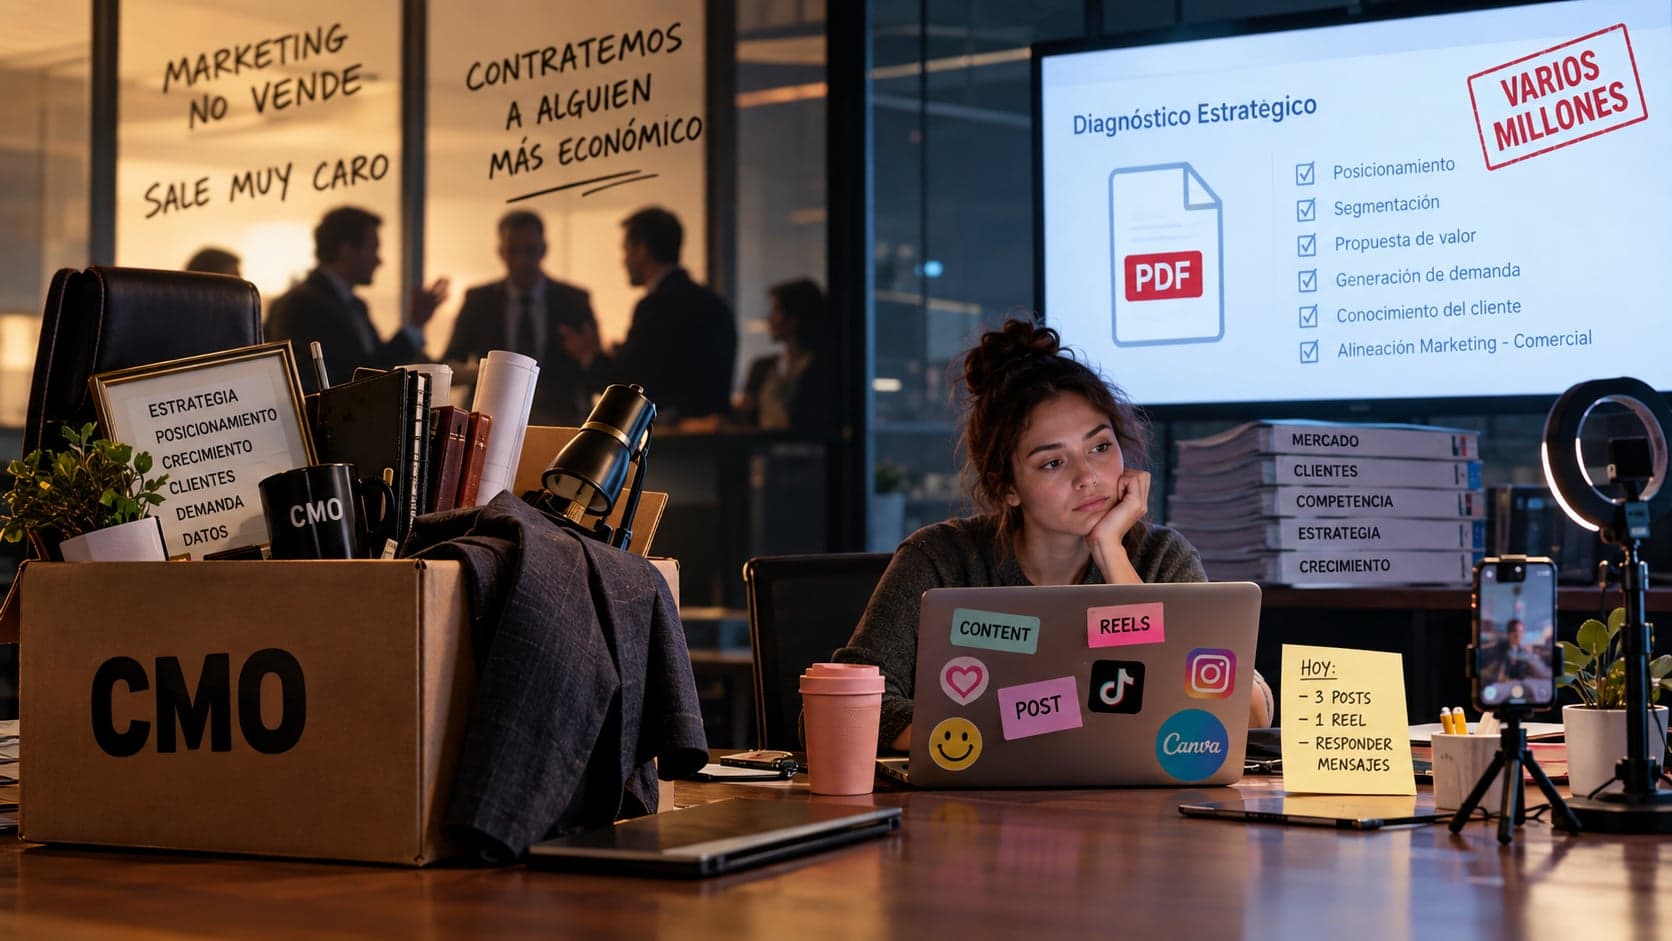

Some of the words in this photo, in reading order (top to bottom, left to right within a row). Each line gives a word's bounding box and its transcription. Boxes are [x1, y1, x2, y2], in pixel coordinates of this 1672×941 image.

[163, 23, 348, 93] MARKETING
[466, 22, 683, 91] CONTRATEMOS
[1500, 49, 1600, 108] VARIOS
[188, 94, 228, 129] NO
[252, 63, 363, 116] VENDE
[506, 101, 522, 130] A
[537, 74, 652, 125] ALGUIEN
[1073, 107, 1191, 137] Diagnóstico
[1198, 95, 1318, 124] Estratégico
[1493, 80, 1629, 152] MILLONES
[489, 136, 543, 179] MÁS
[558, 116, 703, 166] ECONÓMICO
[1333, 157, 1456, 180] Posicionamiento
[144, 177, 210, 219] SALE
[229, 162, 292, 203] MUY
[313, 153, 389, 192] CARO
[1334, 194, 1440, 218] Segmentación
[1335, 233, 1411, 253] Propuesta
[1416, 231, 1434, 245] de
[1439, 228, 1477, 244] valor
[1135, 261, 1190, 292] PDF
[1336, 268, 1421, 288] Generación
[1426, 267, 1444, 282] de
[1449, 262, 1521, 281] demanda
[1337, 304, 1439, 323] Conocimiento
[1443, 301, 1466, 317] del
[1470, 299, 1521, 316] cliente
[1337, 339, 1415, 358] Alineación
[1420, 335, 1497, 354] Marketing
[1514, 329, 1592, 349] Comercial
[148, 388, 239, 419] ESTRATEGIA
[155, 407, 278, 444] POSICIONAMIENTO
[1292, 433, 1359, 448] MERCADO
[162, 439, 253, 470] CRECIMIENTO
[169, 470, 236, 495] CLIENTES
[1294, 464, 1358, 478] CLIENTES
[176, 494, 244, 521] DEMANDA
[289, 497, 344, 529] CMO
[1296, 495, 1394, 509] COMPETENCIA
[183, 525, 229, 547] DATOS
[1298, 526, 1381, 541] ESTRATEGIA
[1299, 558, 1391, 574] CRECIMIENTO
[960, 620, 1032, 642] CONTENT
[1100, 615, 1151, 635] REELS
[1301, 658, 1336, 677] HOY:
[91, 648, 307, 758] CMO
[1015, 695, 1062, 720] POST
[1315, 690, 1324, 704] 3
[1332, 690, 1372, 705] POSTS
[1315, 713, 1325, 727] 1
[1332, 713, 1367, 727] REEL
[1162, 732, 1222, 756] Canva
[1316, 736, 1393, 751] RESPONDER
[1317, 757, 1390, 772] MENSAJES
